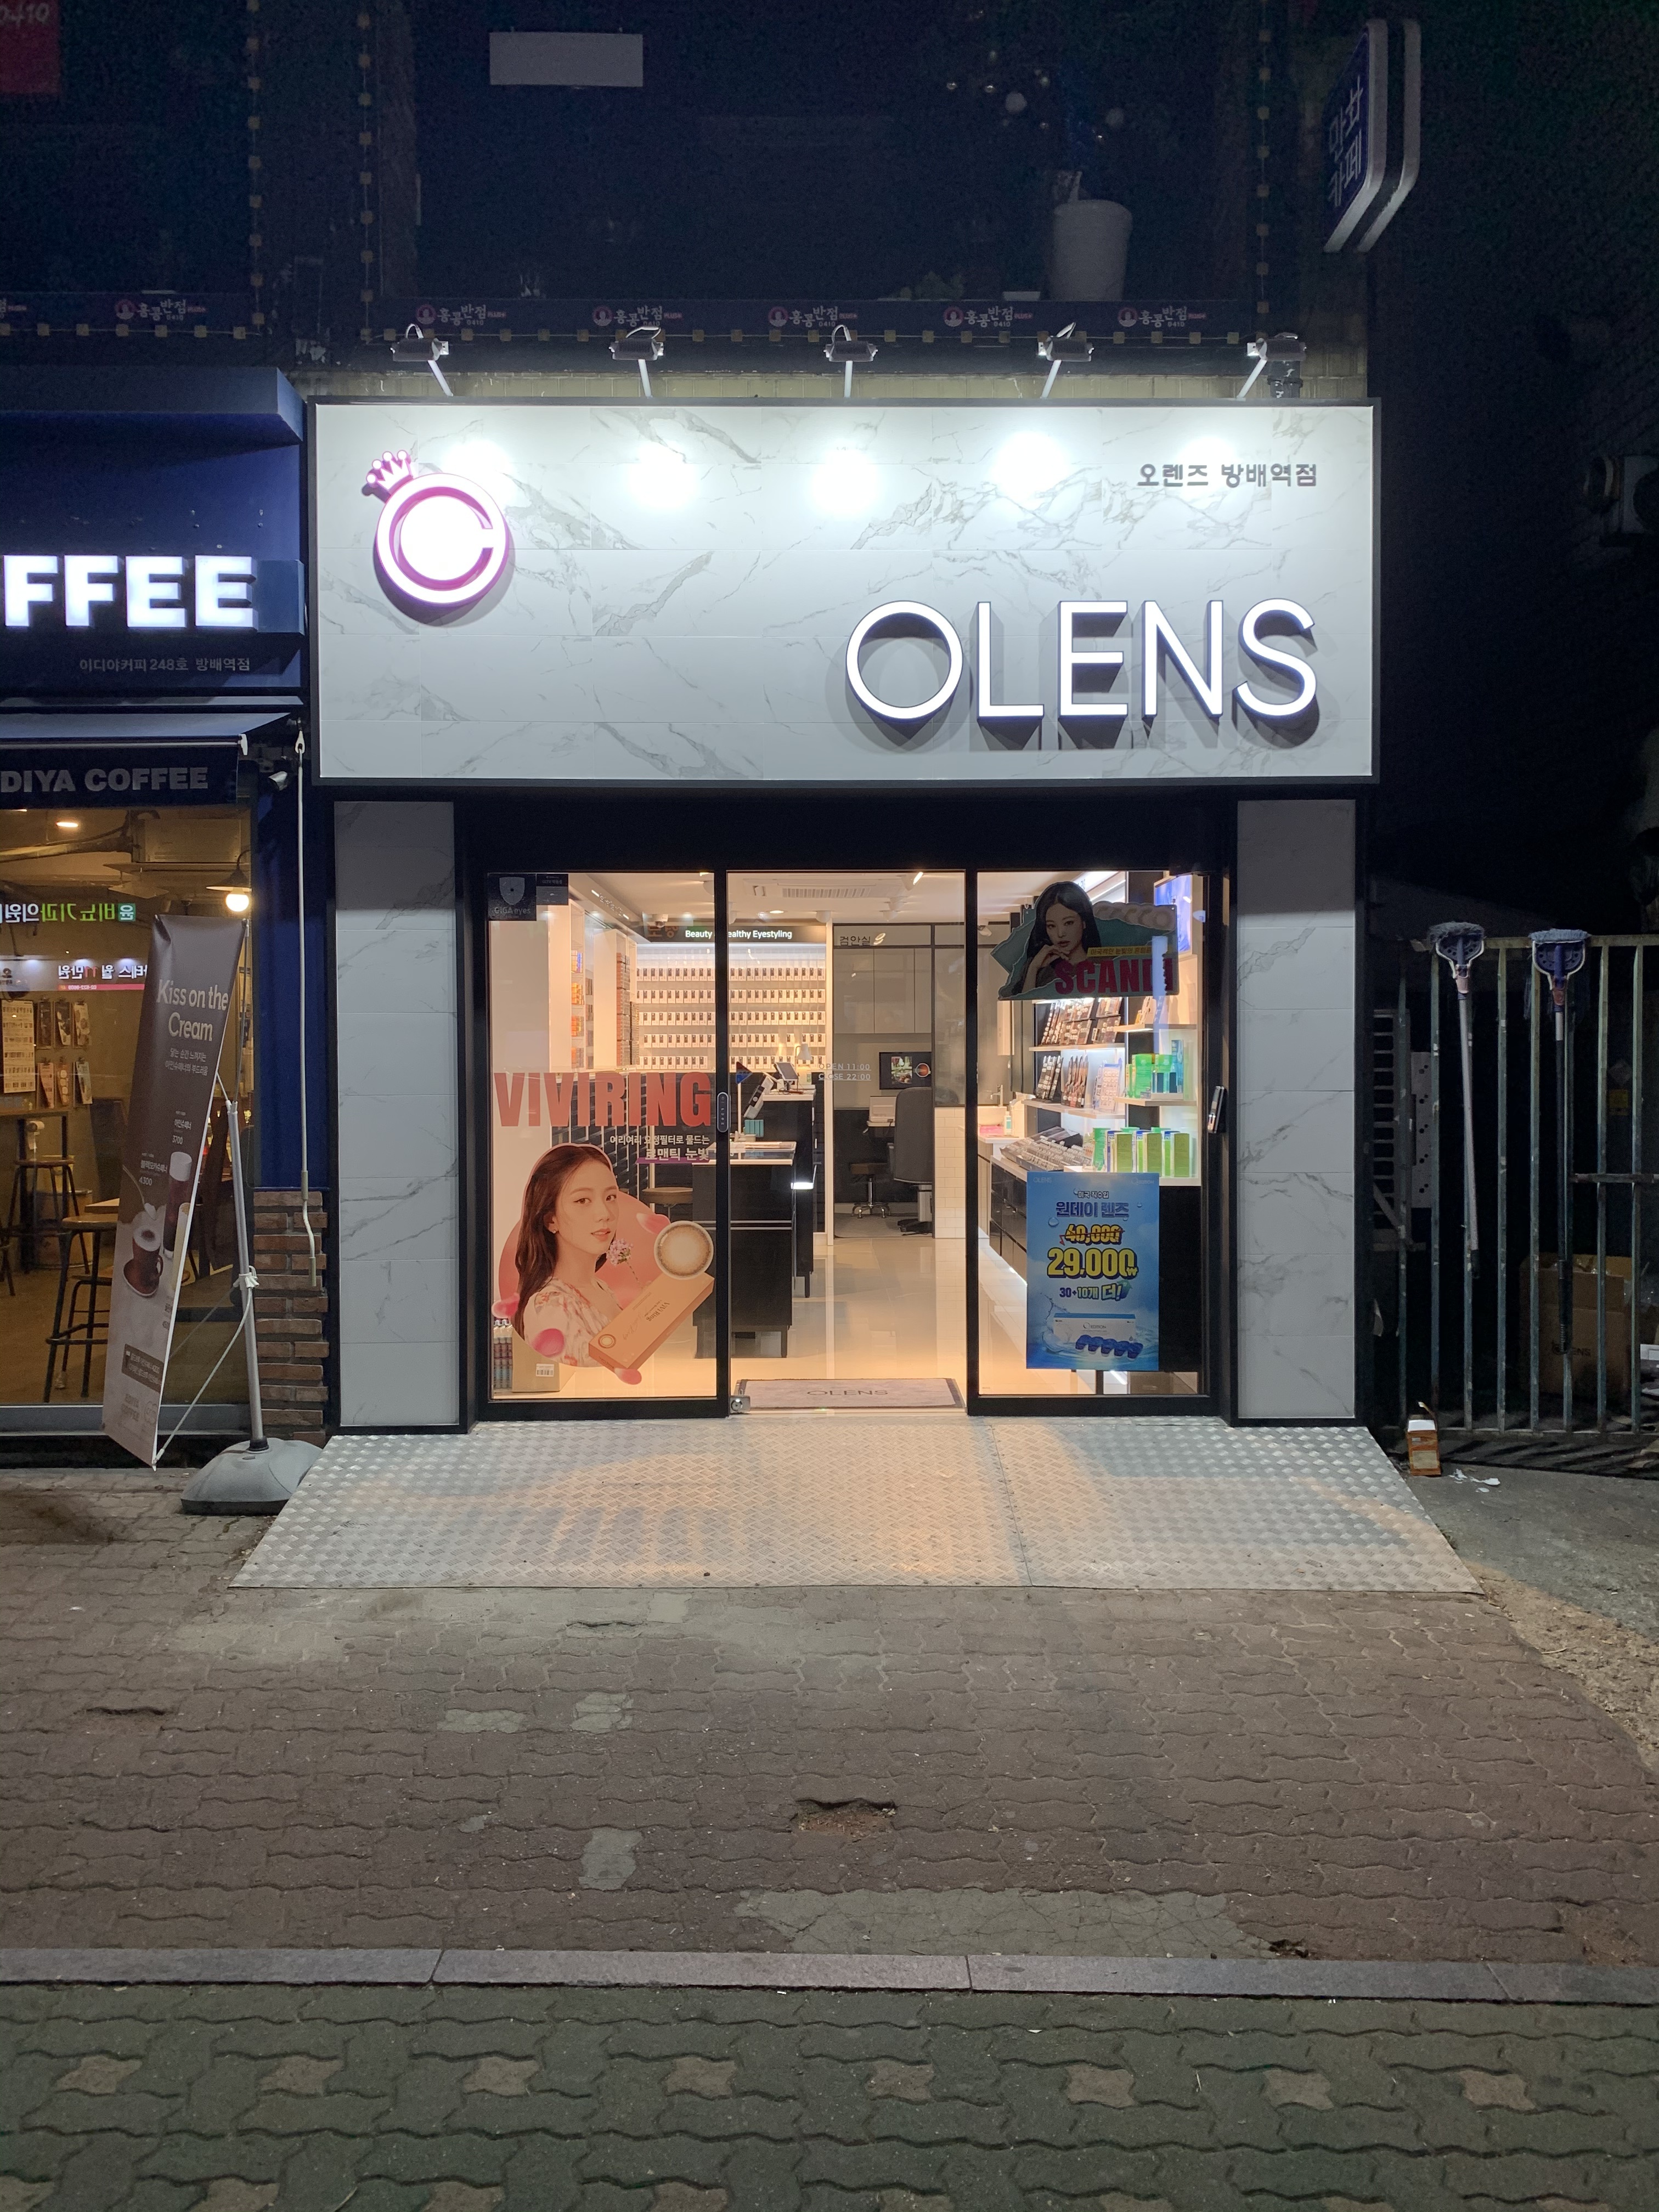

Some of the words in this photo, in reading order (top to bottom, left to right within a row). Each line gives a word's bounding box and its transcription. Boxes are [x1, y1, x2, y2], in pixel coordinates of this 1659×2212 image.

[1329, 75, 1364, 163] 만화
[1328, 129, 1362, 207] 카페
[1137, 464, 1209, 487] 오렌즈
[1221, 463, 1317, 488] 방배역점
[3, 555, 256, 628] FFEE
[80, 658, 146, 672] 이디야커피
[150, 658, 189, 670] 248호
[196, 658, 250, 672] 방배역점
[845, 598, 1317, 720] OLENS
[1, 769, 76, 793] DIYA
[84, 767, 208, 792] COFFEE
[685, 930, 713, 939] Beauty
[753, 930, 793, 939] Eyestyling
[840, 936, 871, 946] 검안실
[156, 979, 187, 1006] Kiss
[188, 990, 206, 1008] on
[208, 984, 229, 1011] the
[168, 1012, 213, 1041] Cream
[494, 1071, 712, 1127] VIVIRING
[172, 1135, 183, 1145] 3700
[610, 1135, 641, 1146] 여리여리
[644, 1135, 684, 1146] 요정필터로
[685, 1135, 710, 1146] 물드는
[645, 1148, 681, 1161] 로맨틱
[685, 1148, 709, 1161] 눈빛
[139, 1176, 153, 1186] 4300
[1091, 1190, 1109, 1199] 직수입
[1056, 1201, 1098, 1218] 원데이
[1101, 1202, 1130, 1218] 렌즈
[1064, 1223, 1122, 1245] 40,000
